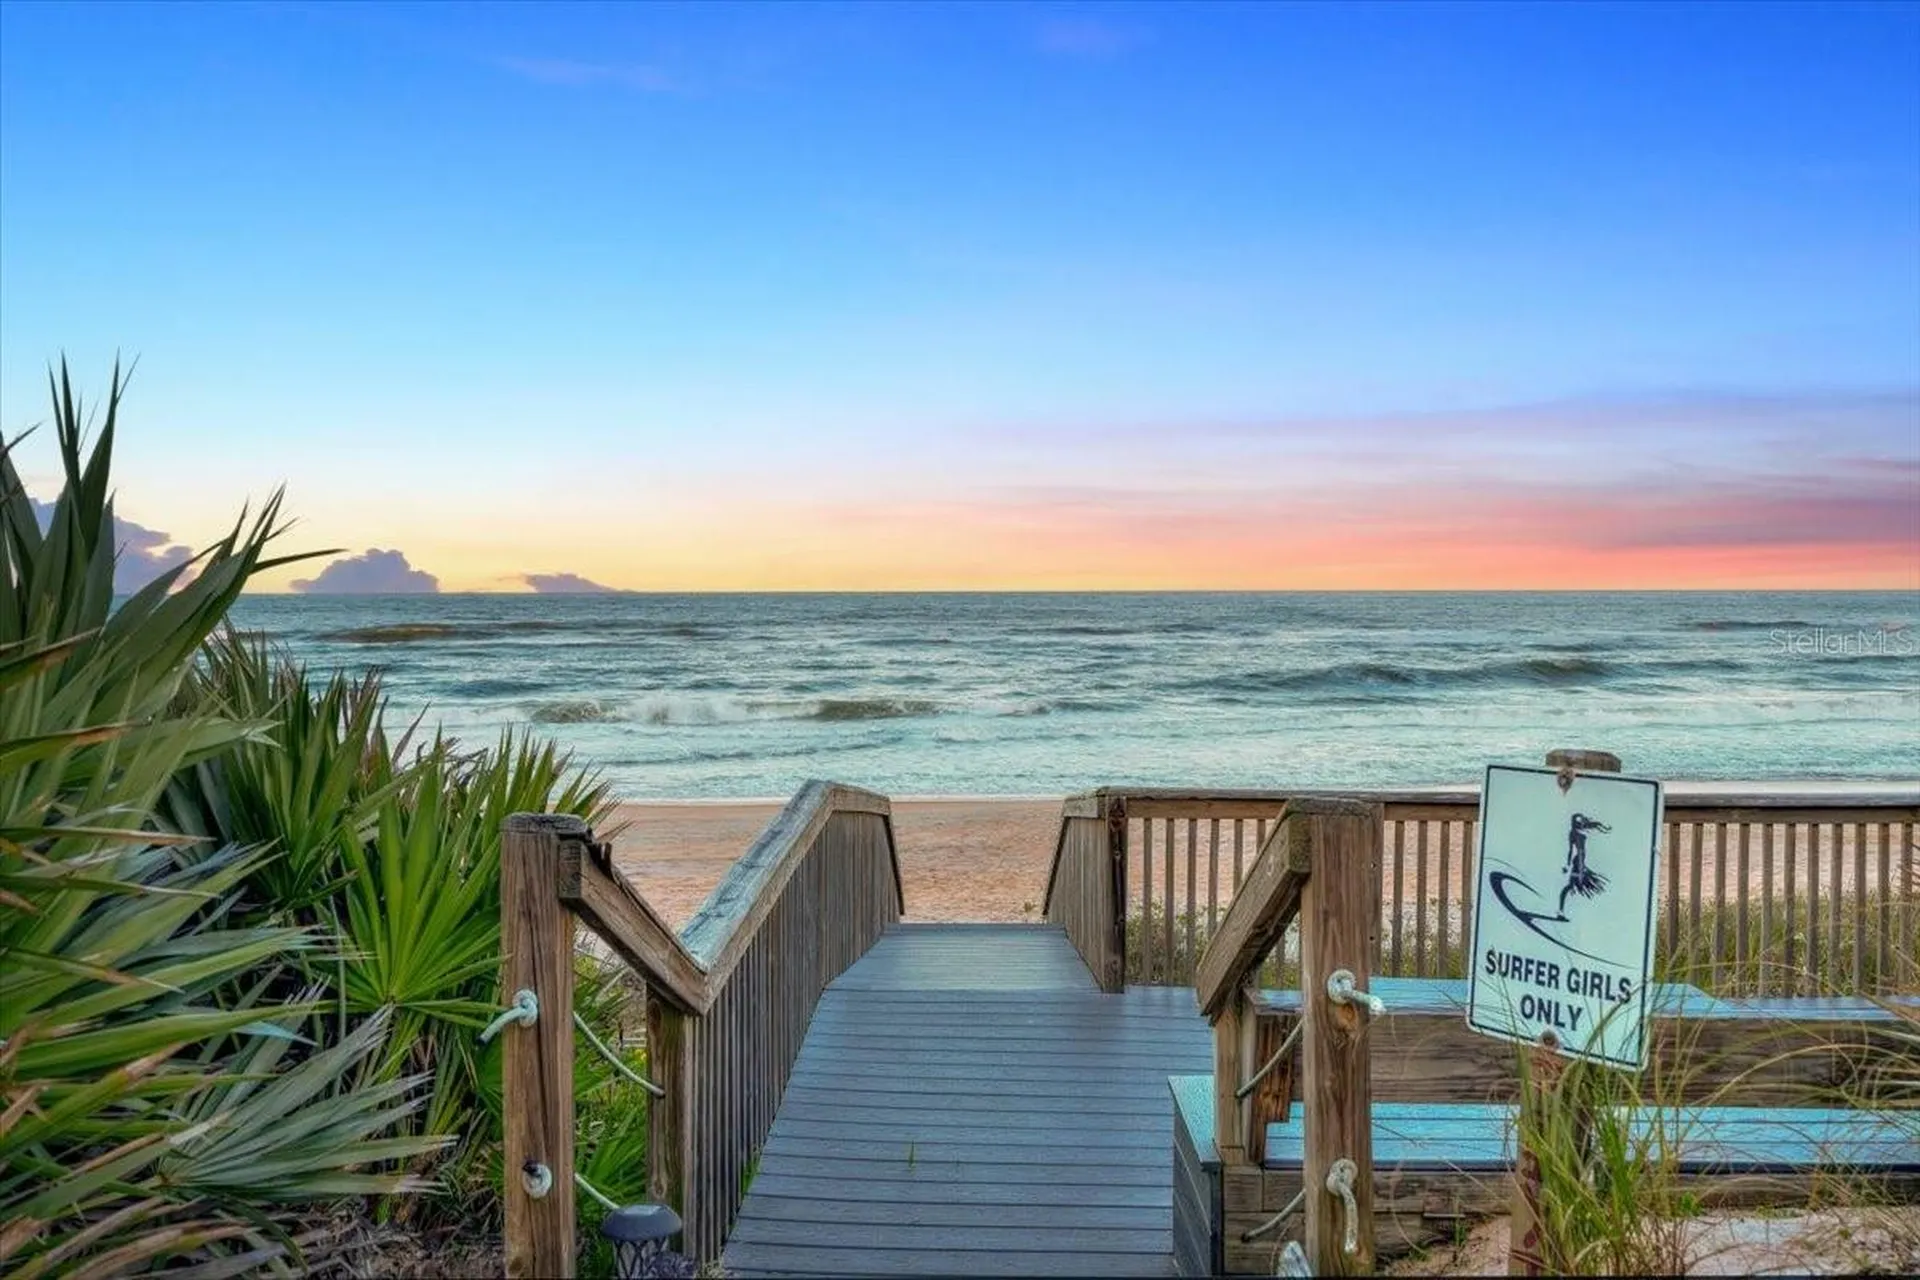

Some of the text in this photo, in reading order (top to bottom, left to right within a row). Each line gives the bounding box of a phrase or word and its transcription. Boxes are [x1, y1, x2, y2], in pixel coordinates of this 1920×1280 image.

[1485, 950, 1632, 1003] SURFER GIRLS
[1520, 994, 1583, 1031] ONLY
